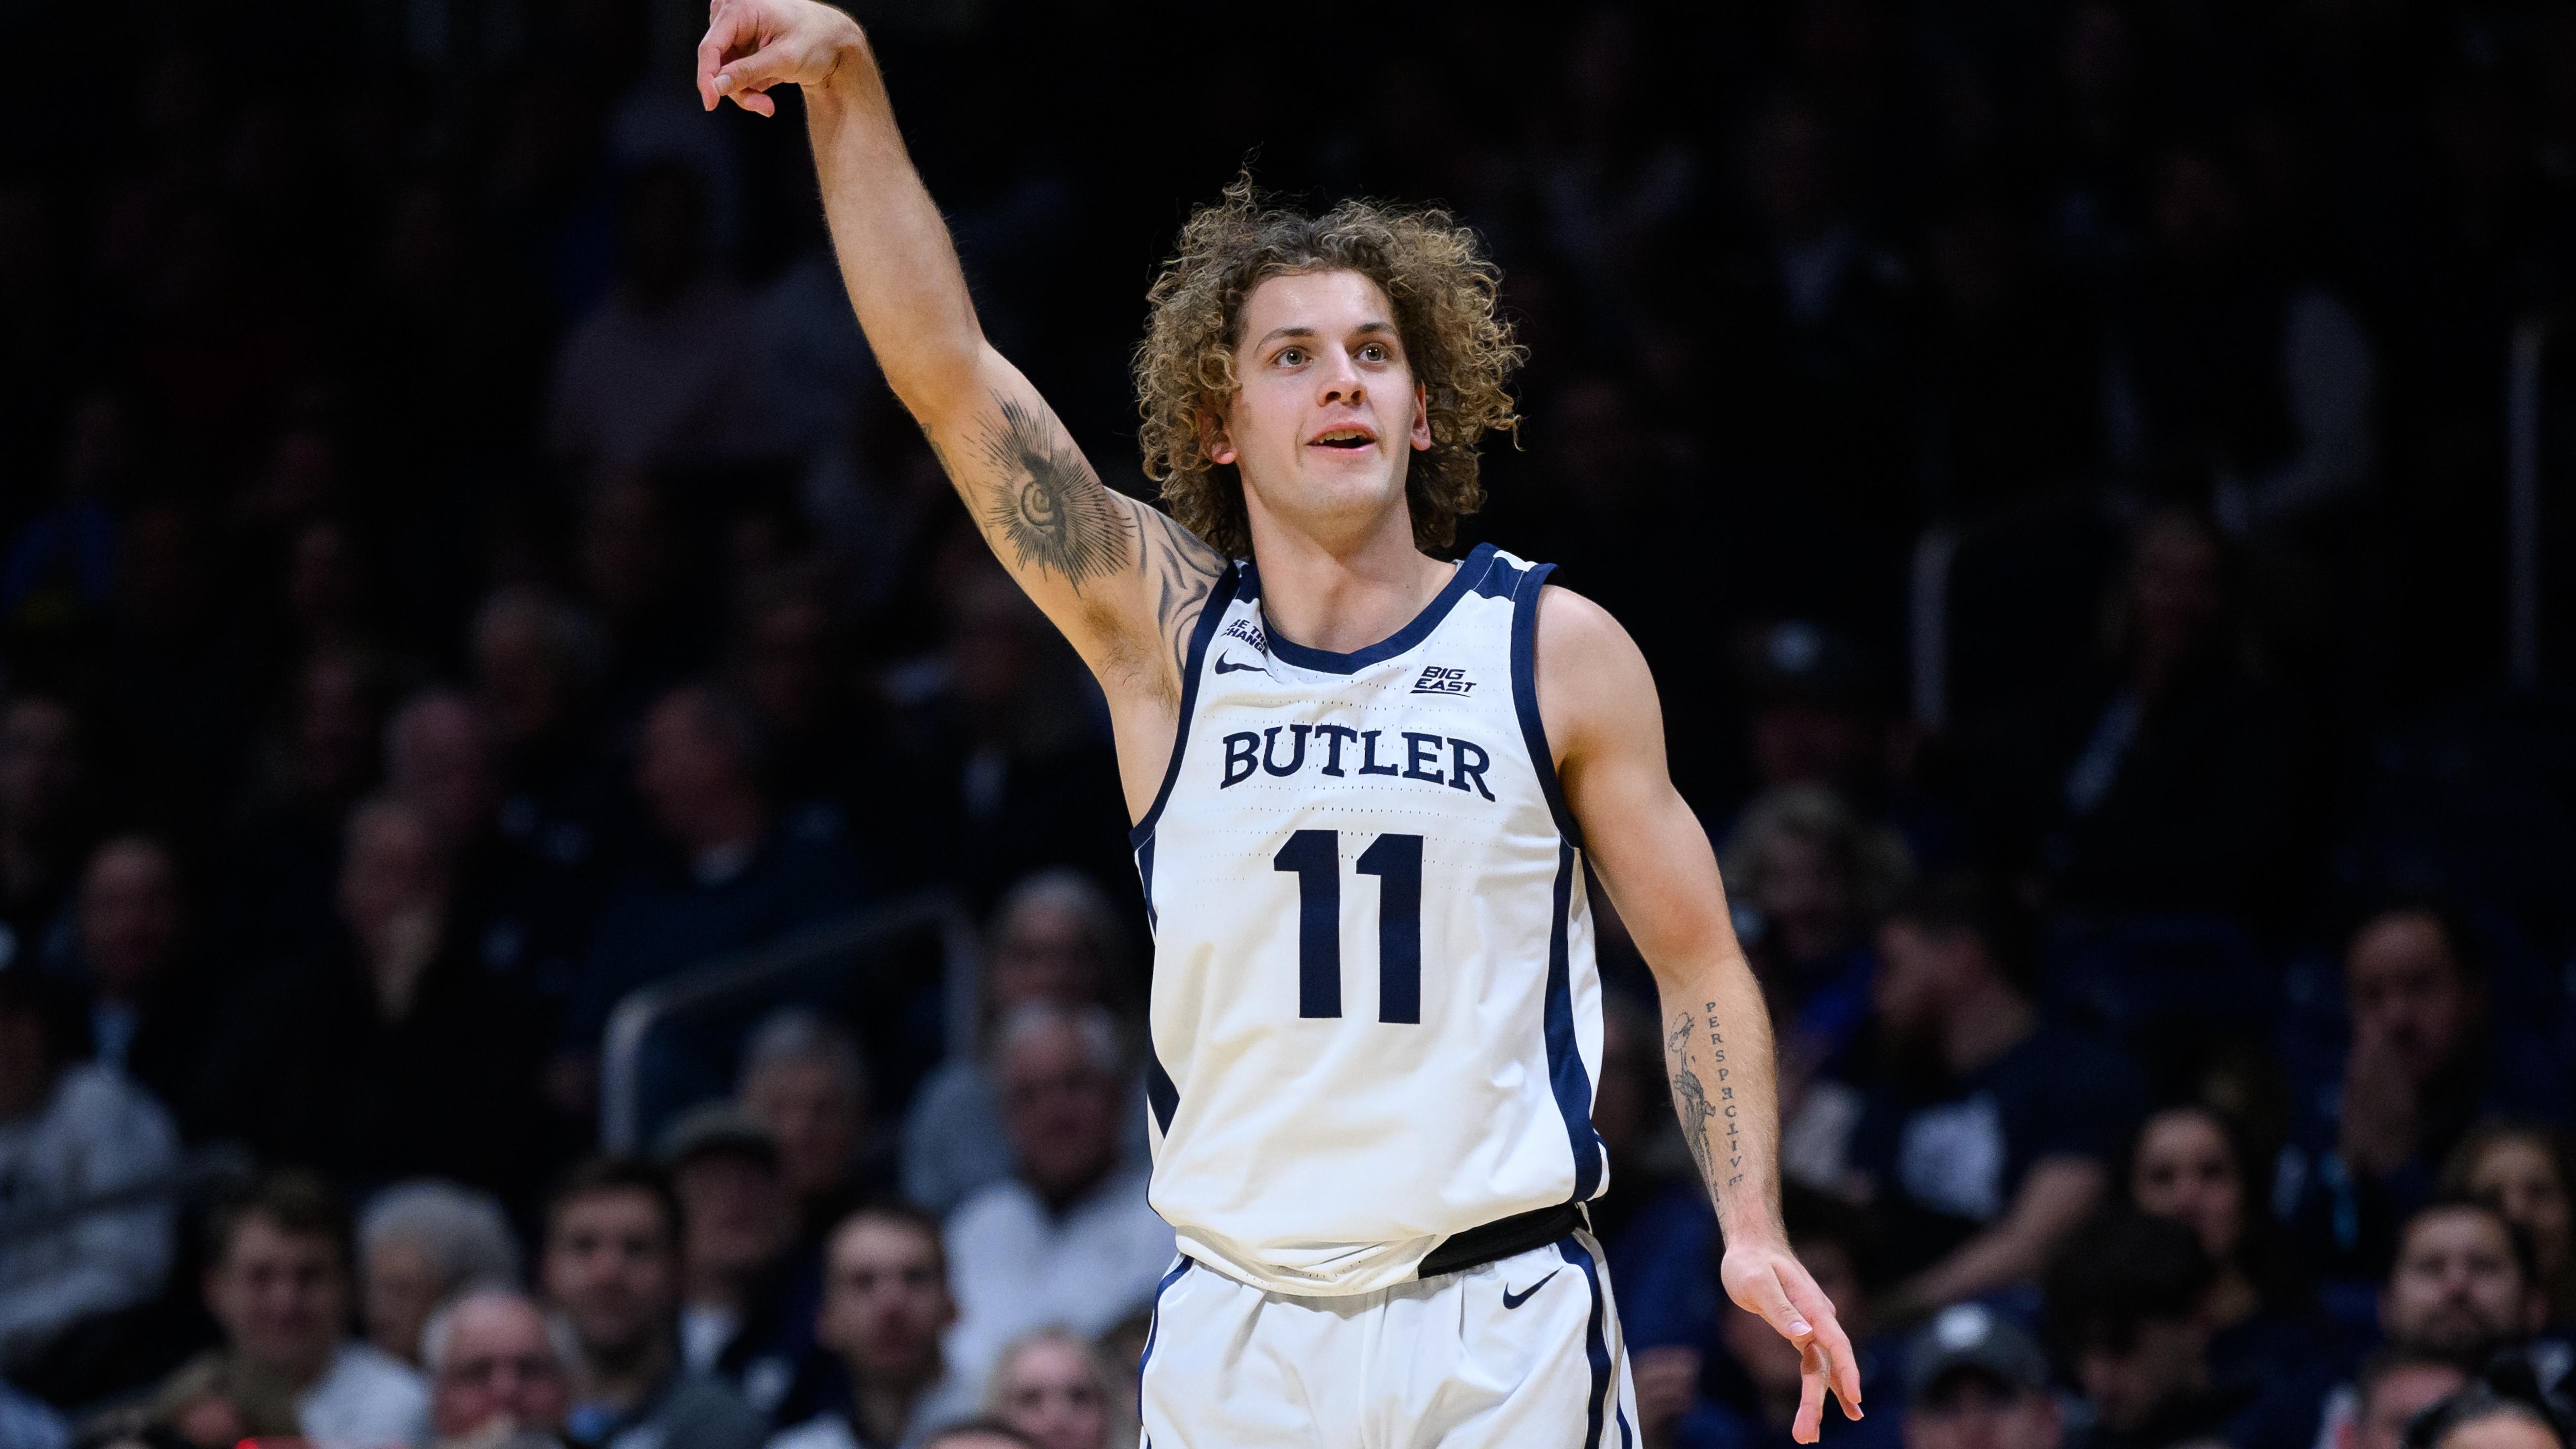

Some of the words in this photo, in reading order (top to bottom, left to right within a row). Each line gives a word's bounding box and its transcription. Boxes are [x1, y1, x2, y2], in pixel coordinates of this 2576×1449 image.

[1414, 678, 1477, 692] EAST
[1421, 666, 1466, 680] BIG
[1220, 724, 1496, 802] BUTLER
[1274, 829, 1423, 1025] 11
